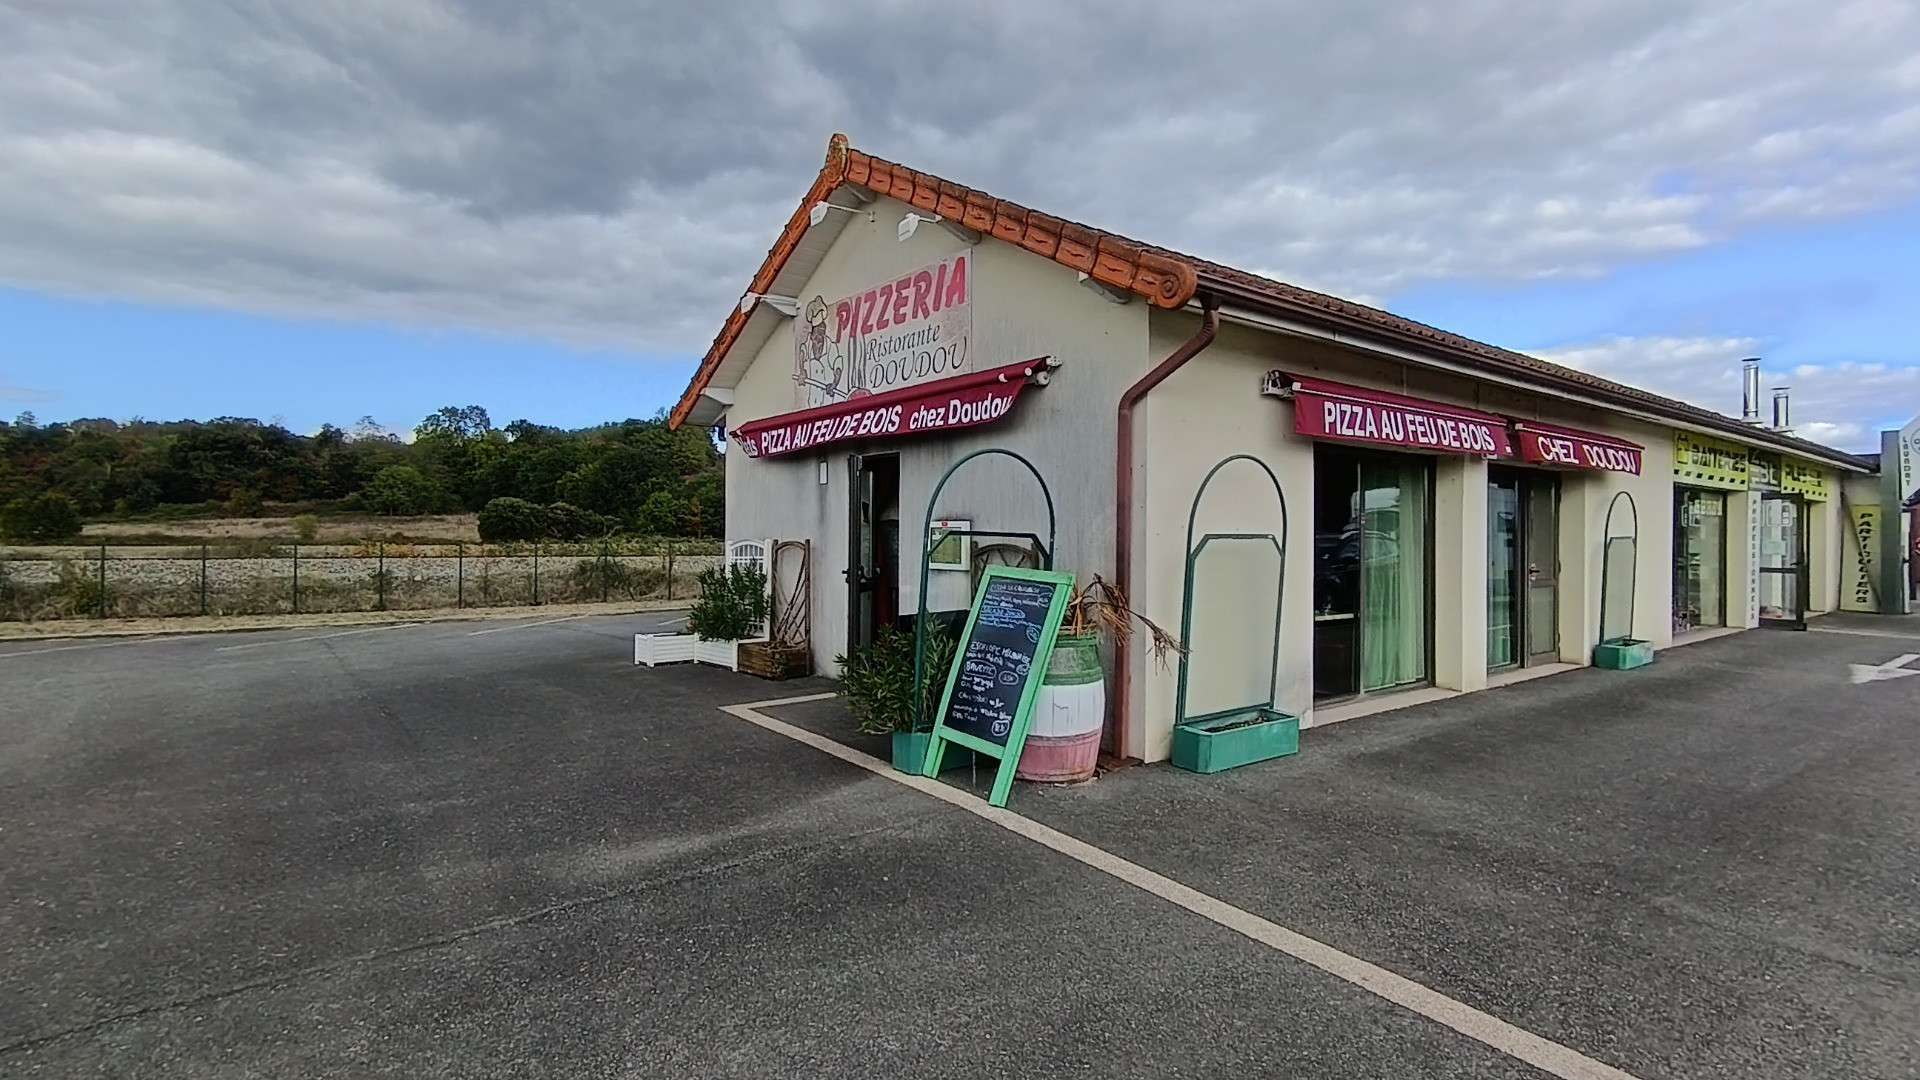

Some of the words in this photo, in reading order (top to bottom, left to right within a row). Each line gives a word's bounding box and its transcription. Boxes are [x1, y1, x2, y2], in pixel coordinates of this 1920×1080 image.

[835, 256, 966, 343] PIZZERIA
[868, 323, 942, 363] Ristorante
[870, 336, 967, 388] DOUDOU
[761, 427, 791, 455] PIZZA
[792, 422, 812, 449] AU
[809, 417, 840, 446] FEU
[835, 413, 862, 439] DE
[857, 405, 902, 434] BOIS
[909, 405, 945, 430] chez
[948, 393, 1013, 425] Doudou
[1324, 401, 1378, 438] PIZZA
[1382, 410, 1404, 441] AU
[1405, 413, 1438, 444] FEU
[1438, 419, 1461, 448] DE
[1459, 422, 1496, 451] BOIS
[1538, 436, 1579, 464] CHEZ
[1582, 444, 1636, 473] DOUDOU
